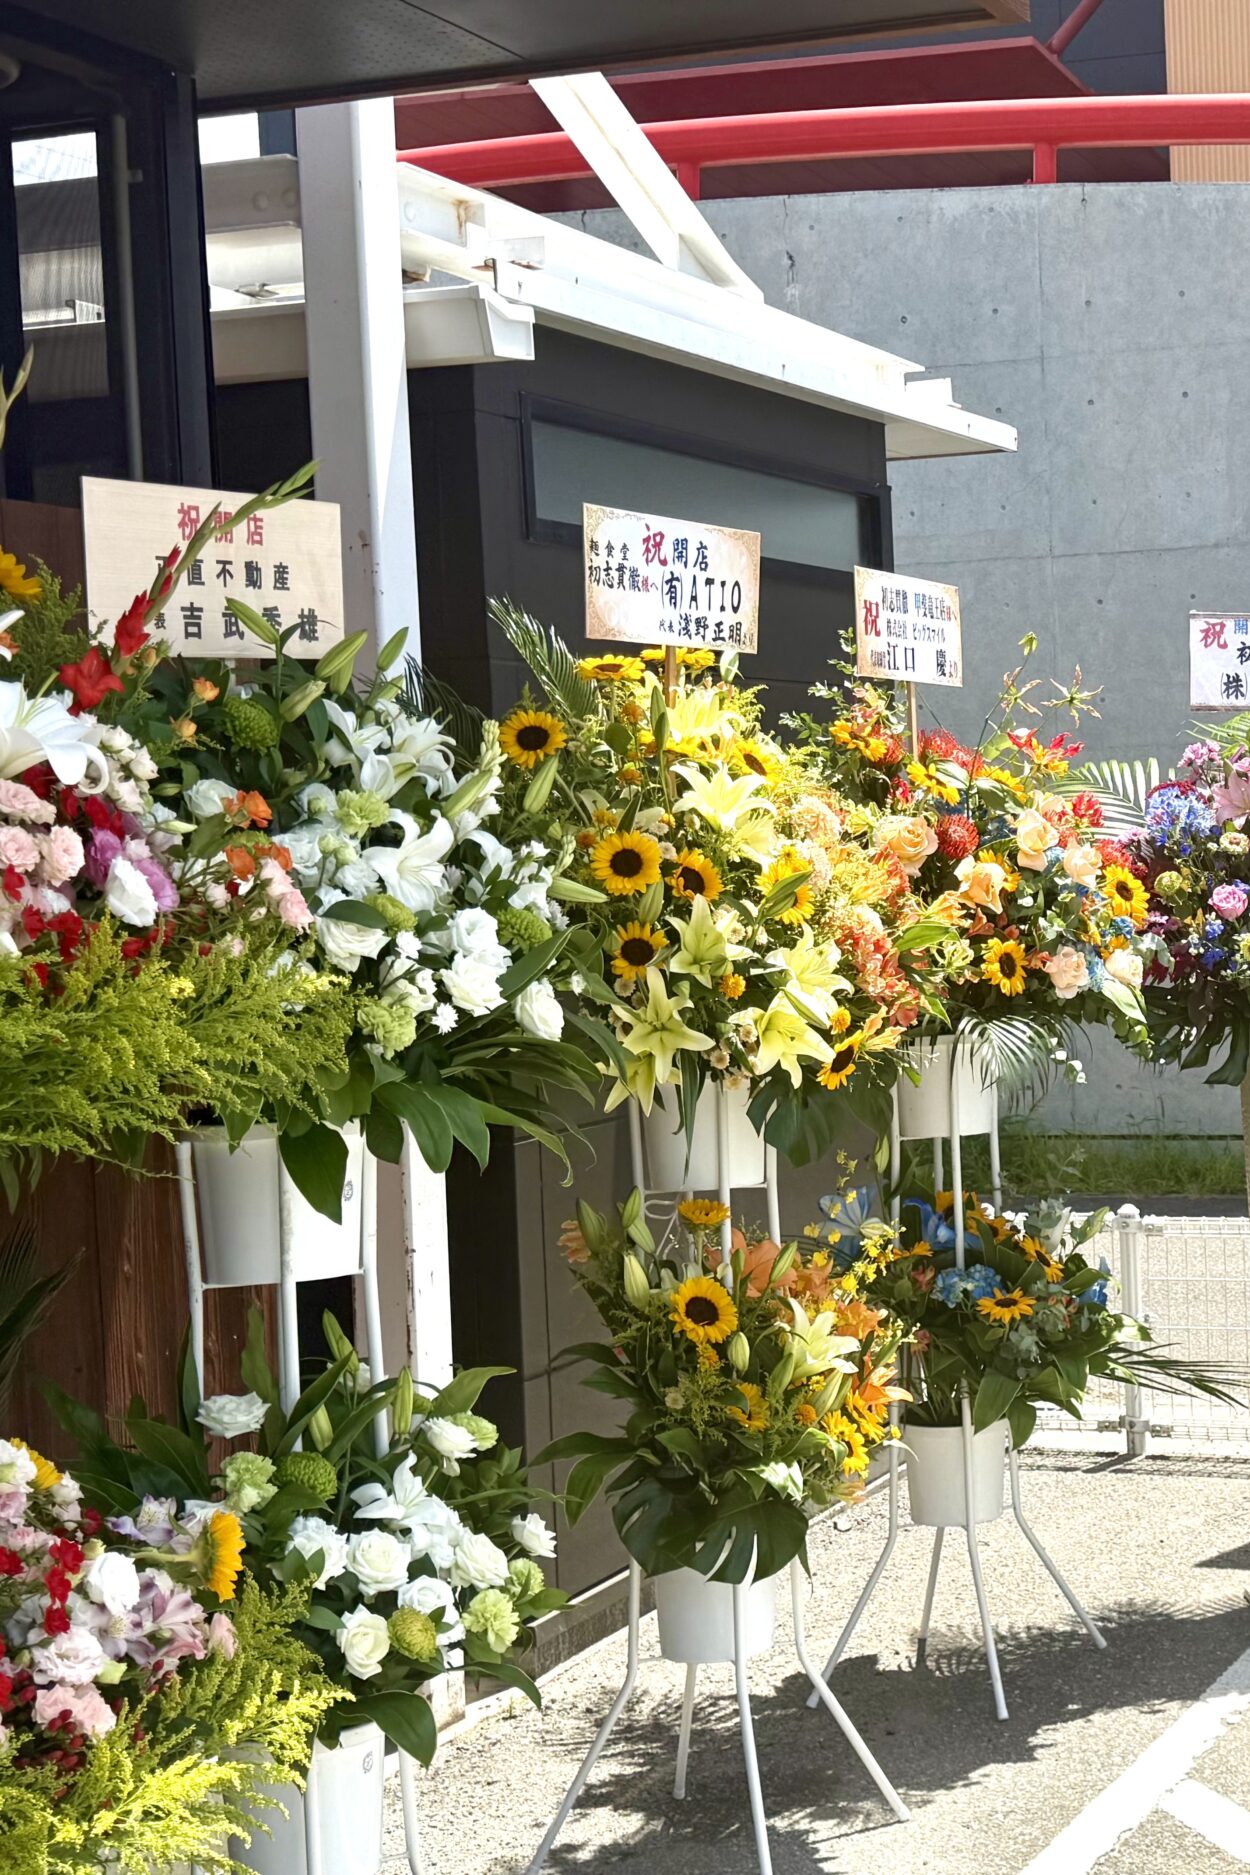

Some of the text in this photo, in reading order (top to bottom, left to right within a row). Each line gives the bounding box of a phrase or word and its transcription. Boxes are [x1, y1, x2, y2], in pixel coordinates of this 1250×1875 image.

[177, 502, 264, 546] 祝開店
[863, 599, 881, 637] 祝
